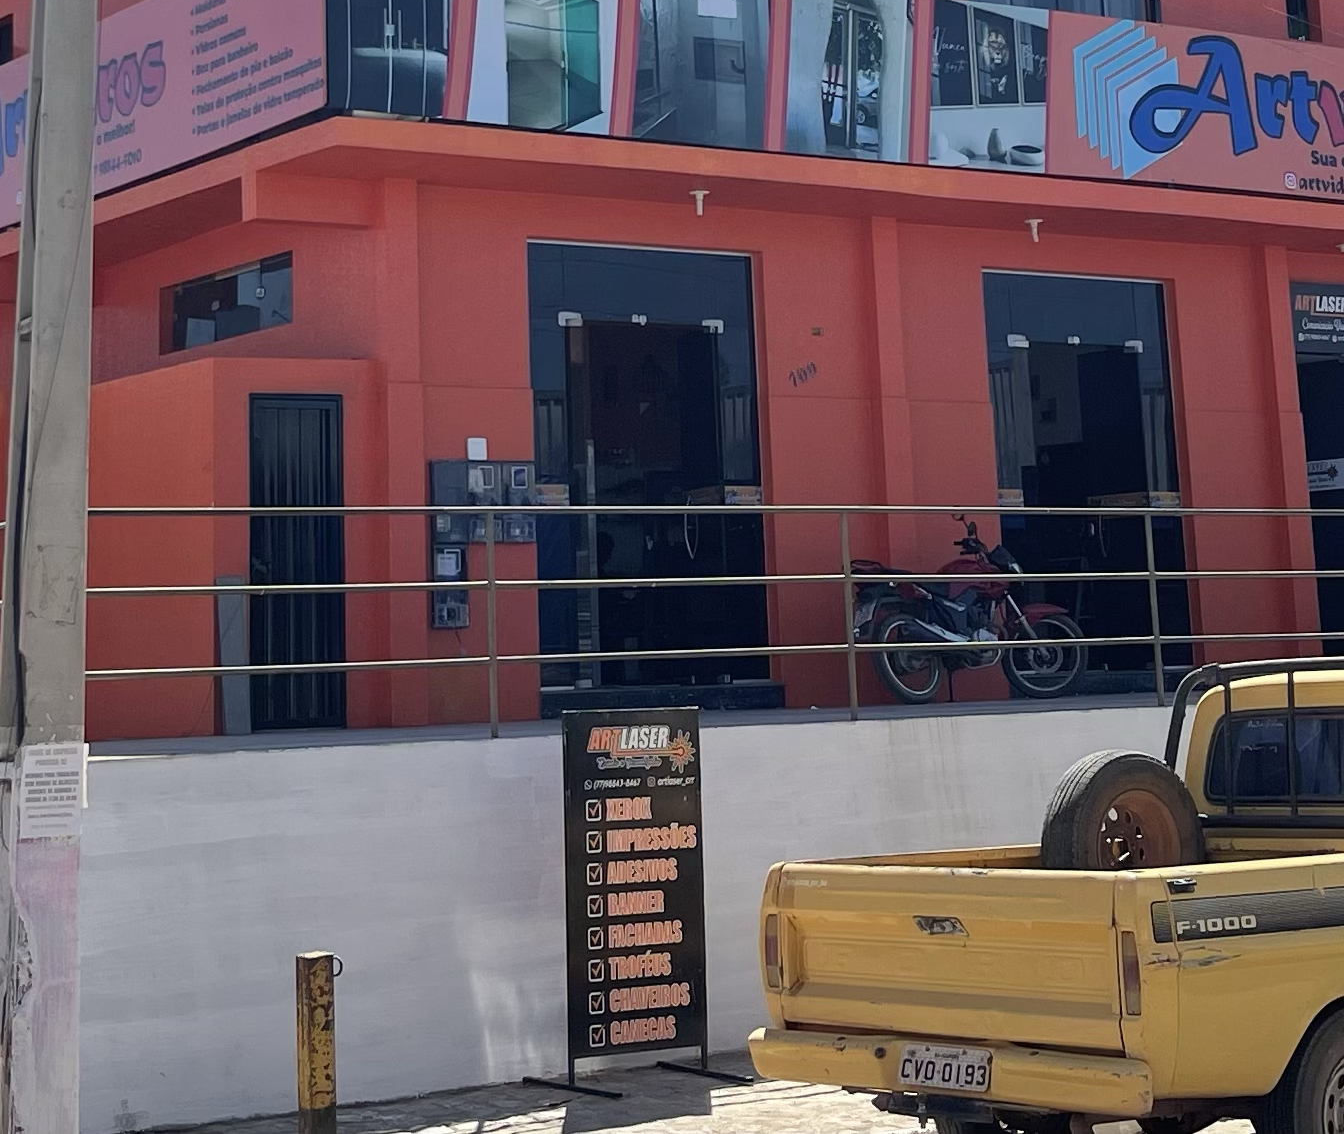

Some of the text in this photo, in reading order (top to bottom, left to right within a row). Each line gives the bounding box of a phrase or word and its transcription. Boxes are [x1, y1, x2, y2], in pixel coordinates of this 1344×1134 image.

[1311, 150, 1337, 168] Sua
[606, 796, 652, 822] XEROX
[607, 822, 696, 853] IMPRESSÕES
[607, 857, 678, 885] ADESIVOS
[607, 890, 664, 917] BANNER
[608, 919, 683, 949] FACHADAS
[608, 949, 671, 981] TROFÉUS
[609, 982, 691, 1013] CHAVEIROS
[610, 1015, 676, 1045] CANECAS
